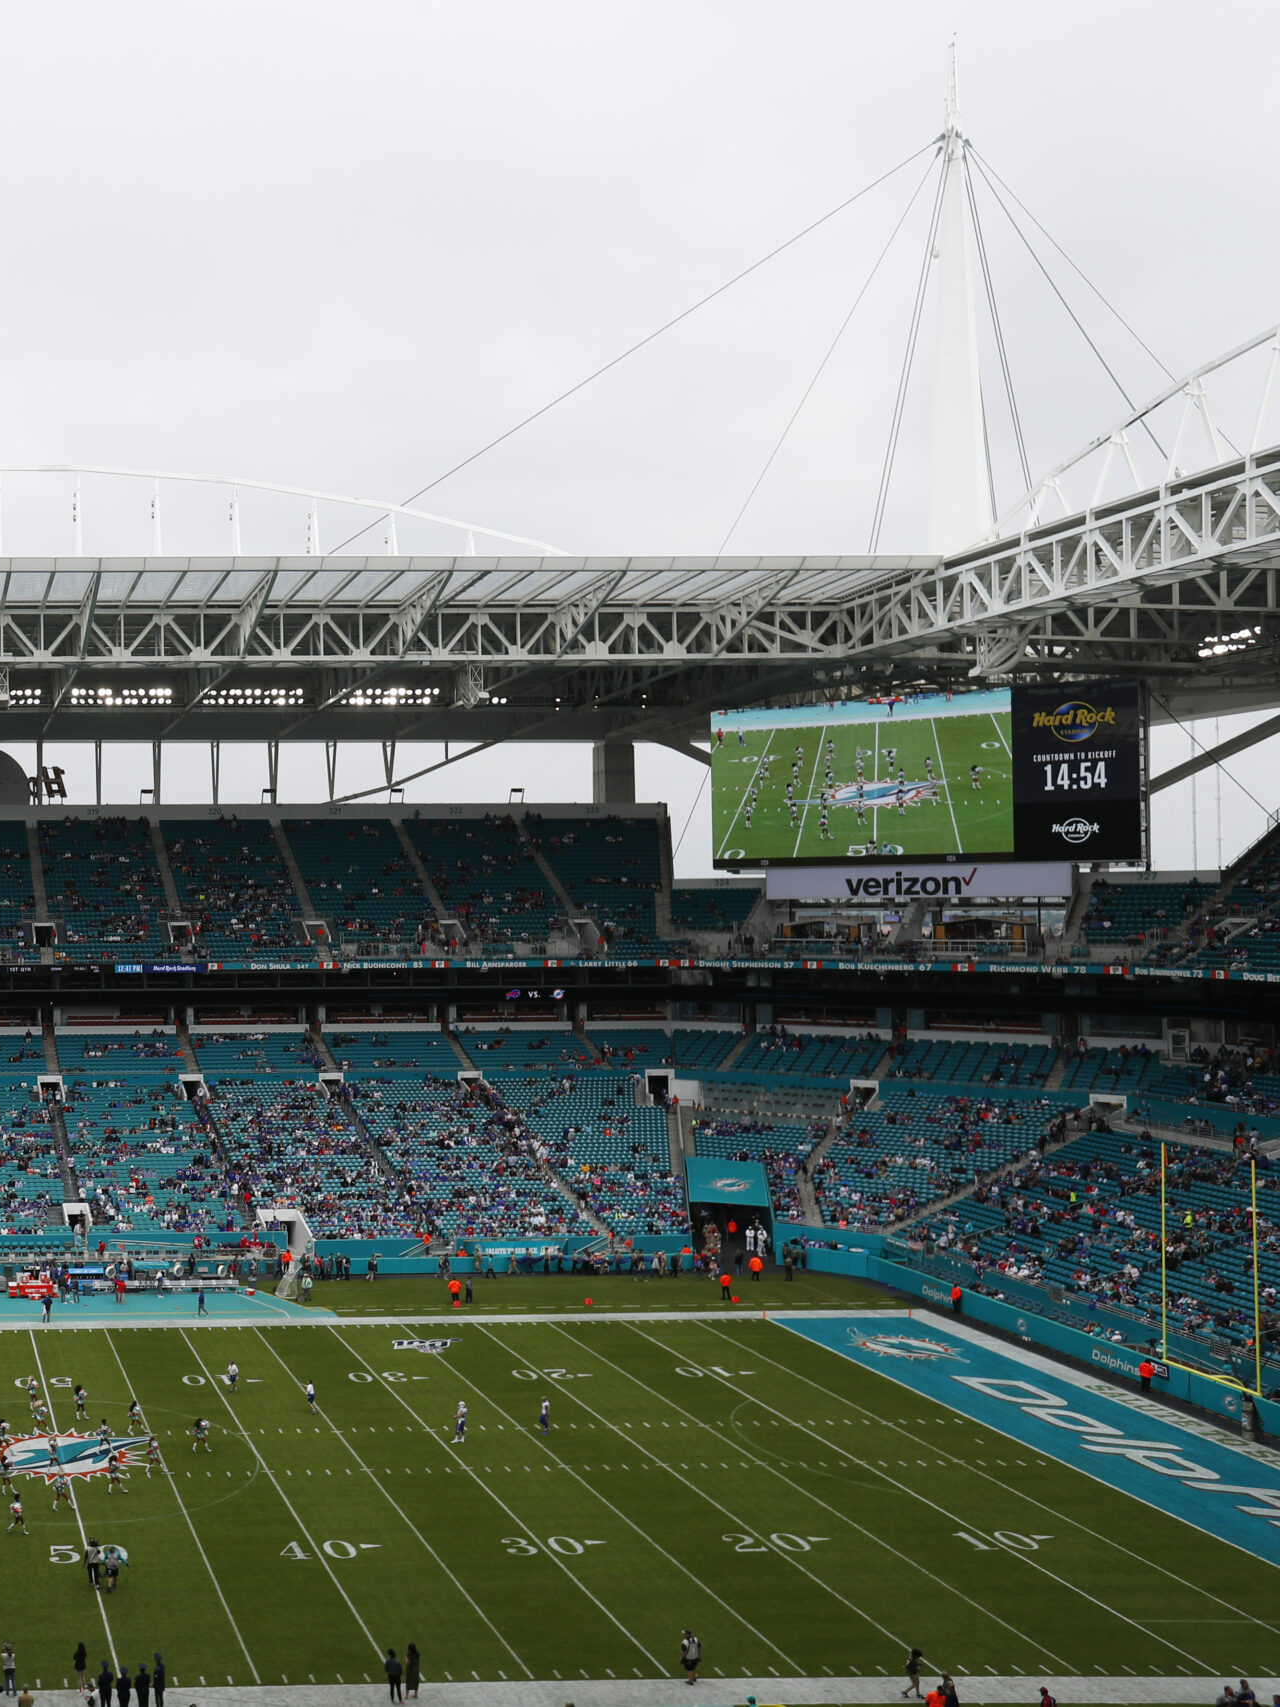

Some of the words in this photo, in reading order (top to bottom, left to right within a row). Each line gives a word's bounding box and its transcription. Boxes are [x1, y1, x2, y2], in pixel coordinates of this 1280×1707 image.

[1032, 709, 1075, 728] Hard
[1075, 706, 1116, 726] Rock
[1033, 752, 1075, 763] COUNTDOWN
[1077, 751, 1085, 760] TO
[1087, 750, 1117, 759] KICKOFF
[1044, 760, 1108, 791] 14:54
[1051, 822, 1075, 833] Hard
[1076, 822, 1100, 833] Rock
[1136, 872, 1157, 881] 327
[845, 871, 962, 896] verizon
[732, 961, 781, 969] STEPHENSON
[838, 962, 856, 970] BOB
[856, 963, 914, 971] KUECHENBERG
[918, 963, 932, 971] 67
[989, 964, 1038, 973] RICHMOND
[1041, 965, 1068, 974] WEBB
[1073, 965, 1087, 974] 78
[1134, 967, 1149, 976] BOB
[1242, 972, 1265, 982] DOUG
[921, 1284, 953, 1305] Dolphin
[1091, 1349, 1141, 1376] Dolphins
[347, 1371, 408, 1383] 30
[511, 1368, 579, 1381] 20
[500, 1536, 585, 1556] 30
[722, 1532, 811, 1552] 20
[952, 1530, 1040, 1551] 10
[279, 1540, 357, 1560] 40
